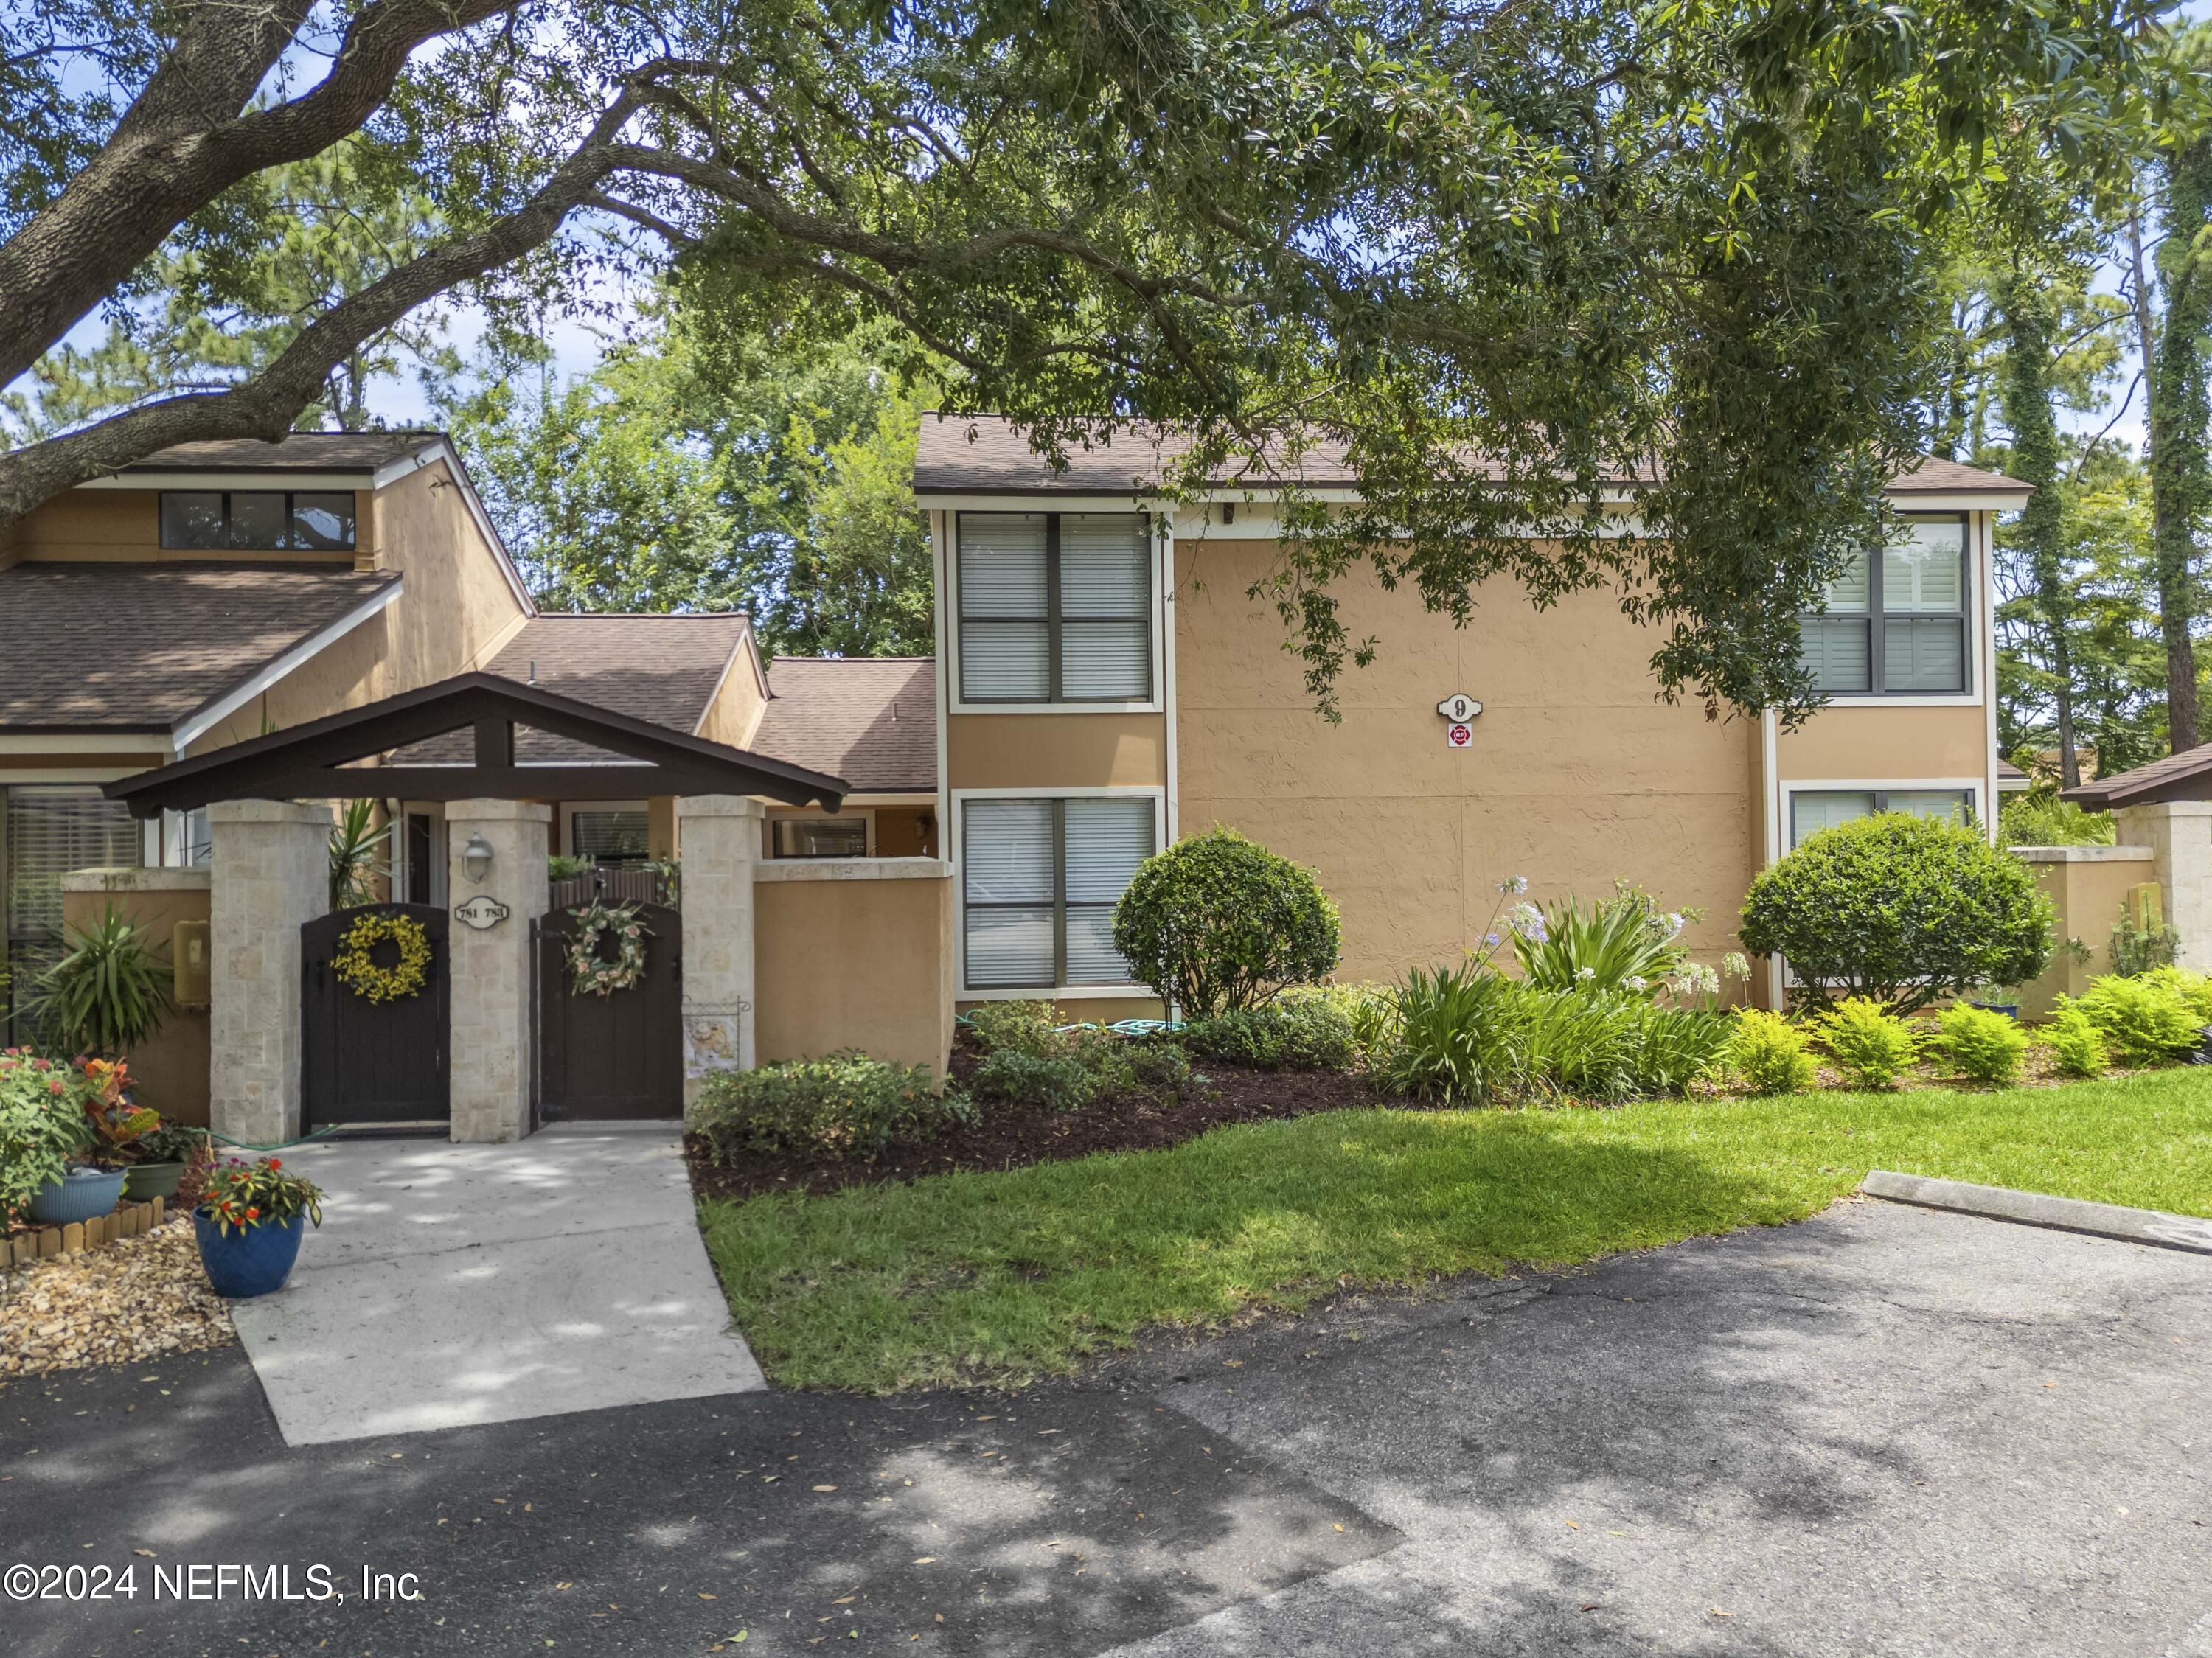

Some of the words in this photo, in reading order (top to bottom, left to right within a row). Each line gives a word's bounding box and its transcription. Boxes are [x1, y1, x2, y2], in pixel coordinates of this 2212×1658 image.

[1455, 700, 1466, 717] 9
[459, 908, 477, 919] 781
[485, 908, 503, 918] 783
